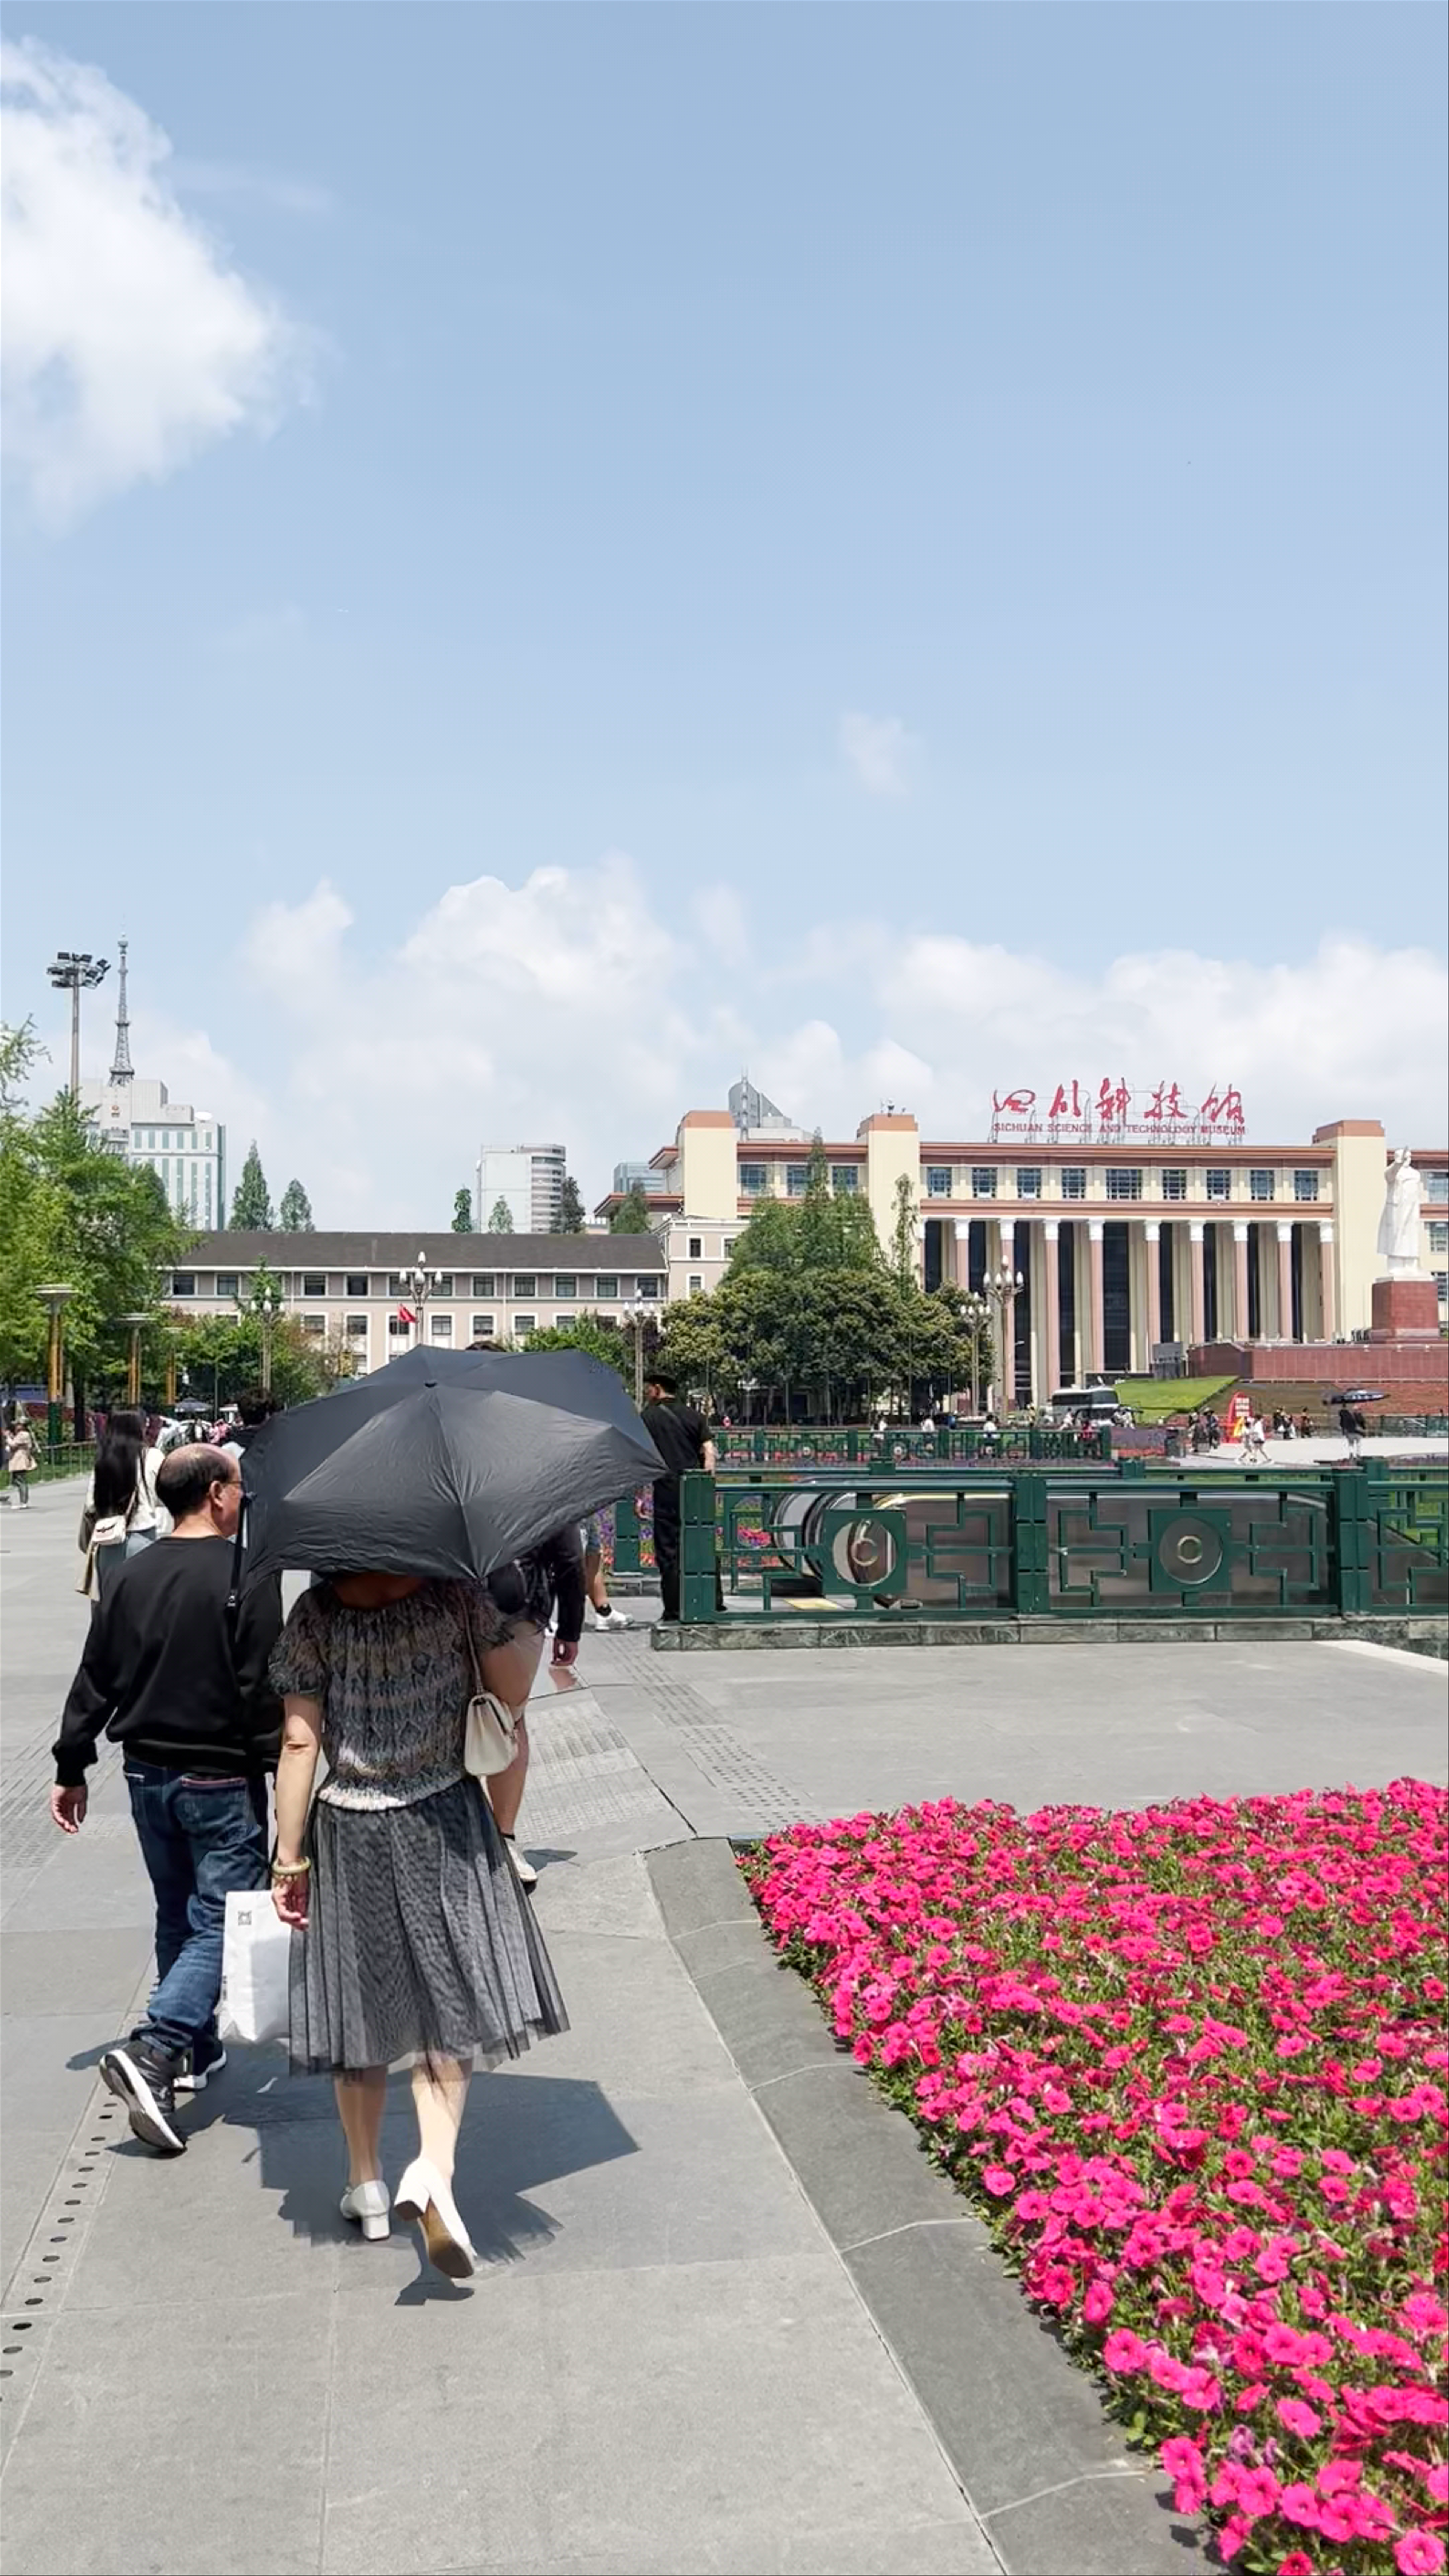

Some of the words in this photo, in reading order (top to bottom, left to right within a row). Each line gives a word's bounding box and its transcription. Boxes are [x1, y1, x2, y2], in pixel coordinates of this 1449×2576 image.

[994, 1123, 1042, 1132] SICHUAN
[1047, 1123, 1092, 1132] SCIENCE
[1100, 1124, 1120, 1133] AND
[1127, 1125, 1196, 1133] TECHNOLOGY
[1201, 1126, 1245, 1135] MUSEUM
